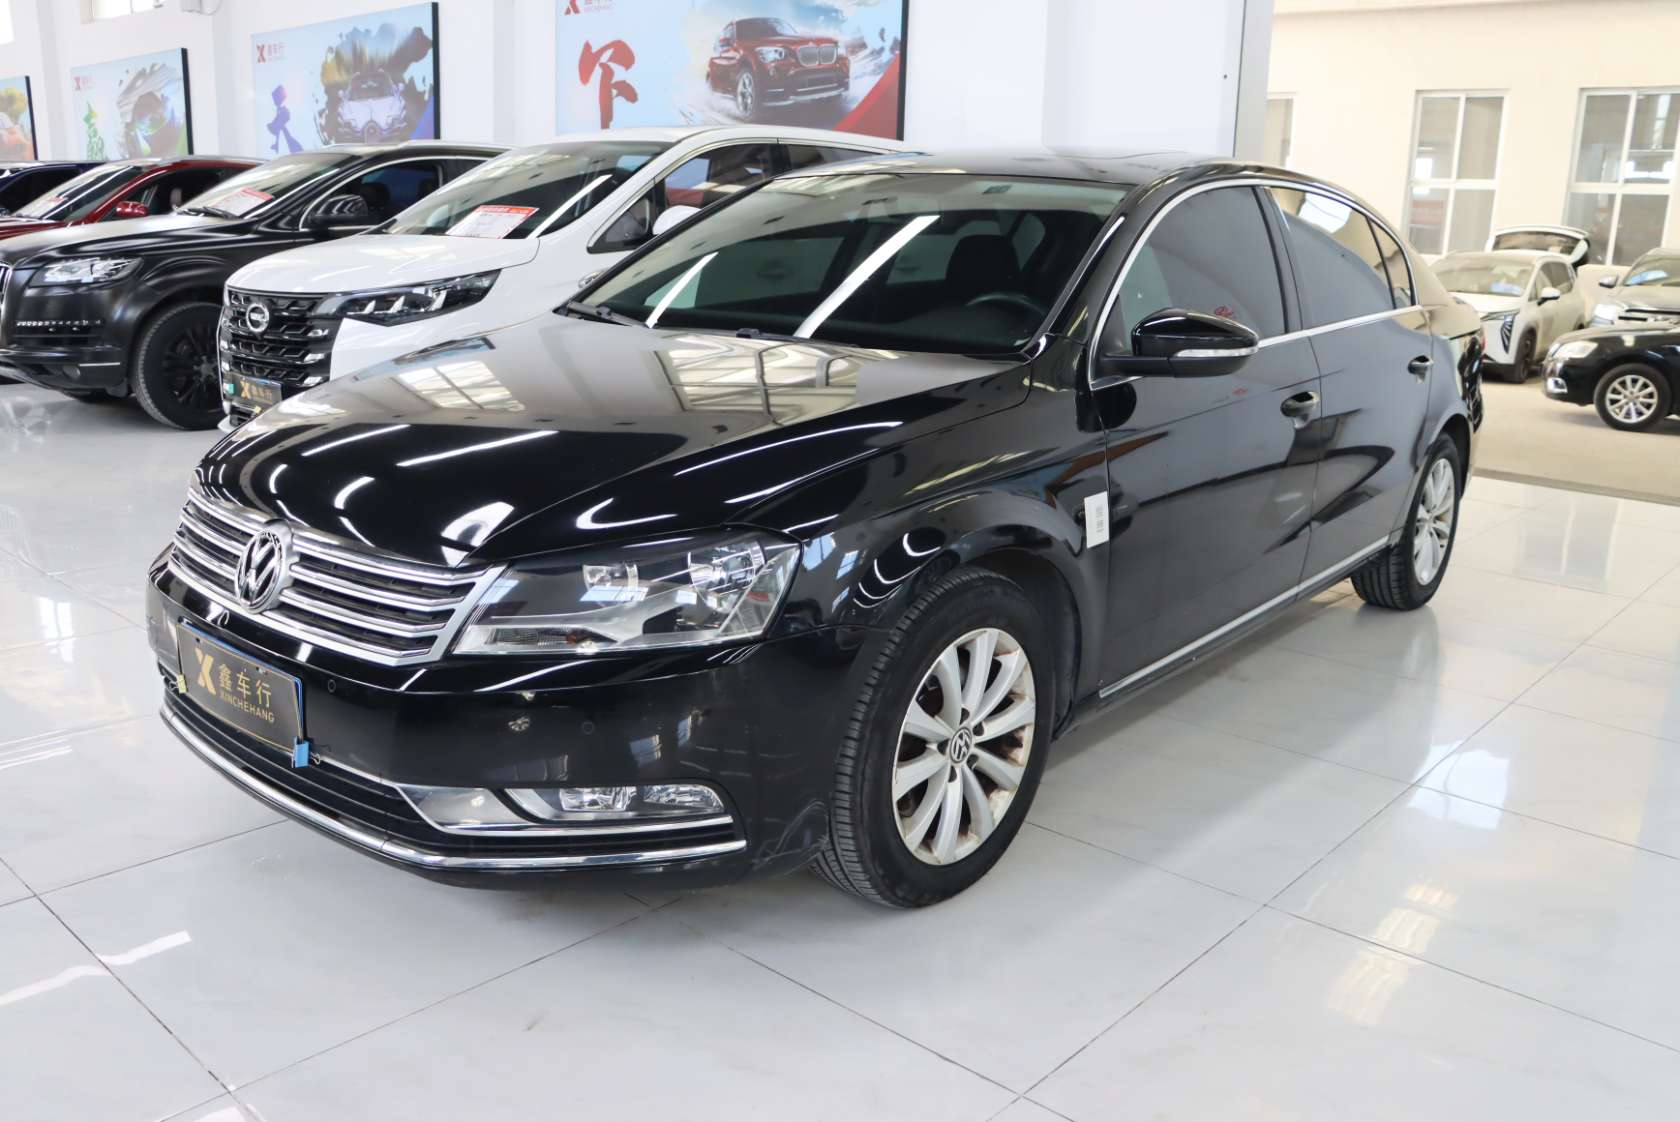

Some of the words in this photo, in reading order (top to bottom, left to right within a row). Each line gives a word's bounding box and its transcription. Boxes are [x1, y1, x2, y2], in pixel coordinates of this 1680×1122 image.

[218, 662, 272, 708] 鑫车行
[219, 690, 275, 724] XINCHEHANG
